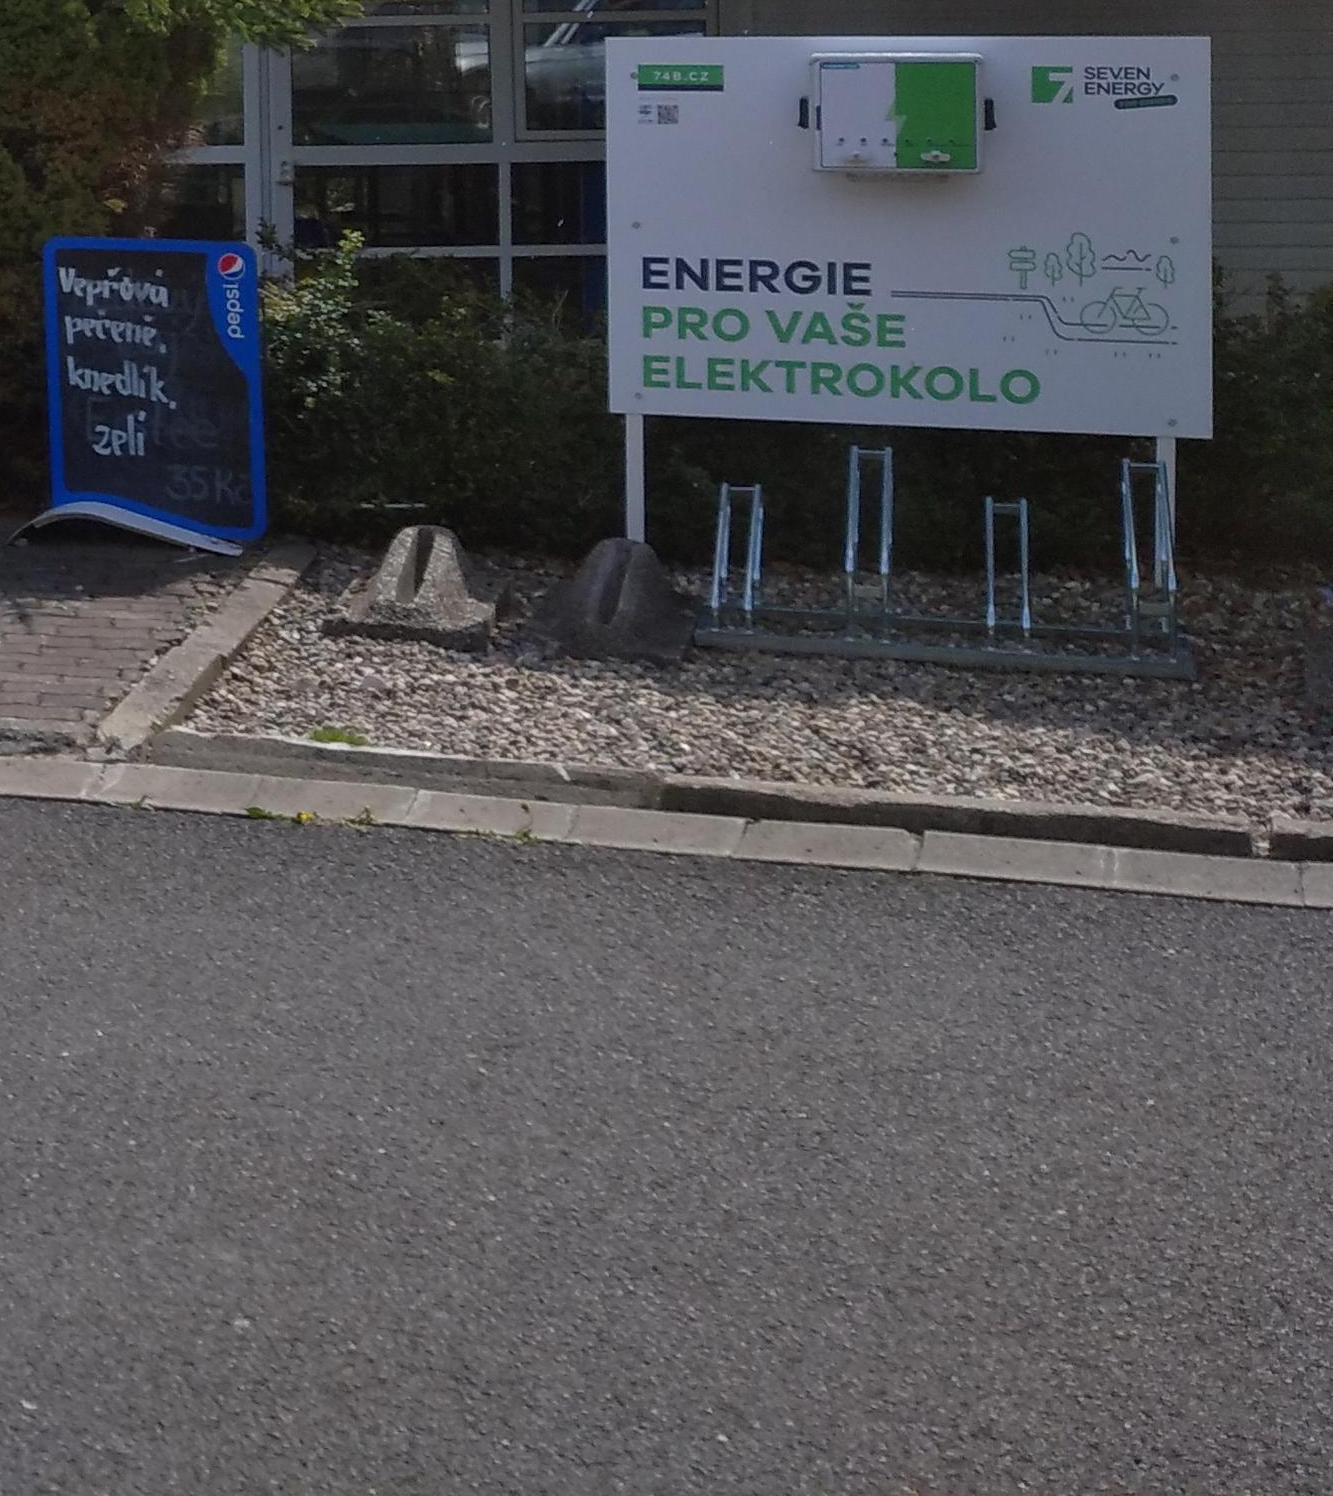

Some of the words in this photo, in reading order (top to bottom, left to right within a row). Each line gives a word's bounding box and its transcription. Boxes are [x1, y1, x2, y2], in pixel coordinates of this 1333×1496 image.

[1084, 81, 1165, 96] ENERGY
[641, 256, 873, 297] ENERGIE
[223, 283, 246, 339] pepsi
[642, 305, 751, 343] PRO
[765, 302, 907, 349] VAŠE
[643, 354, 1042, 405] ELEKTROKOLO
